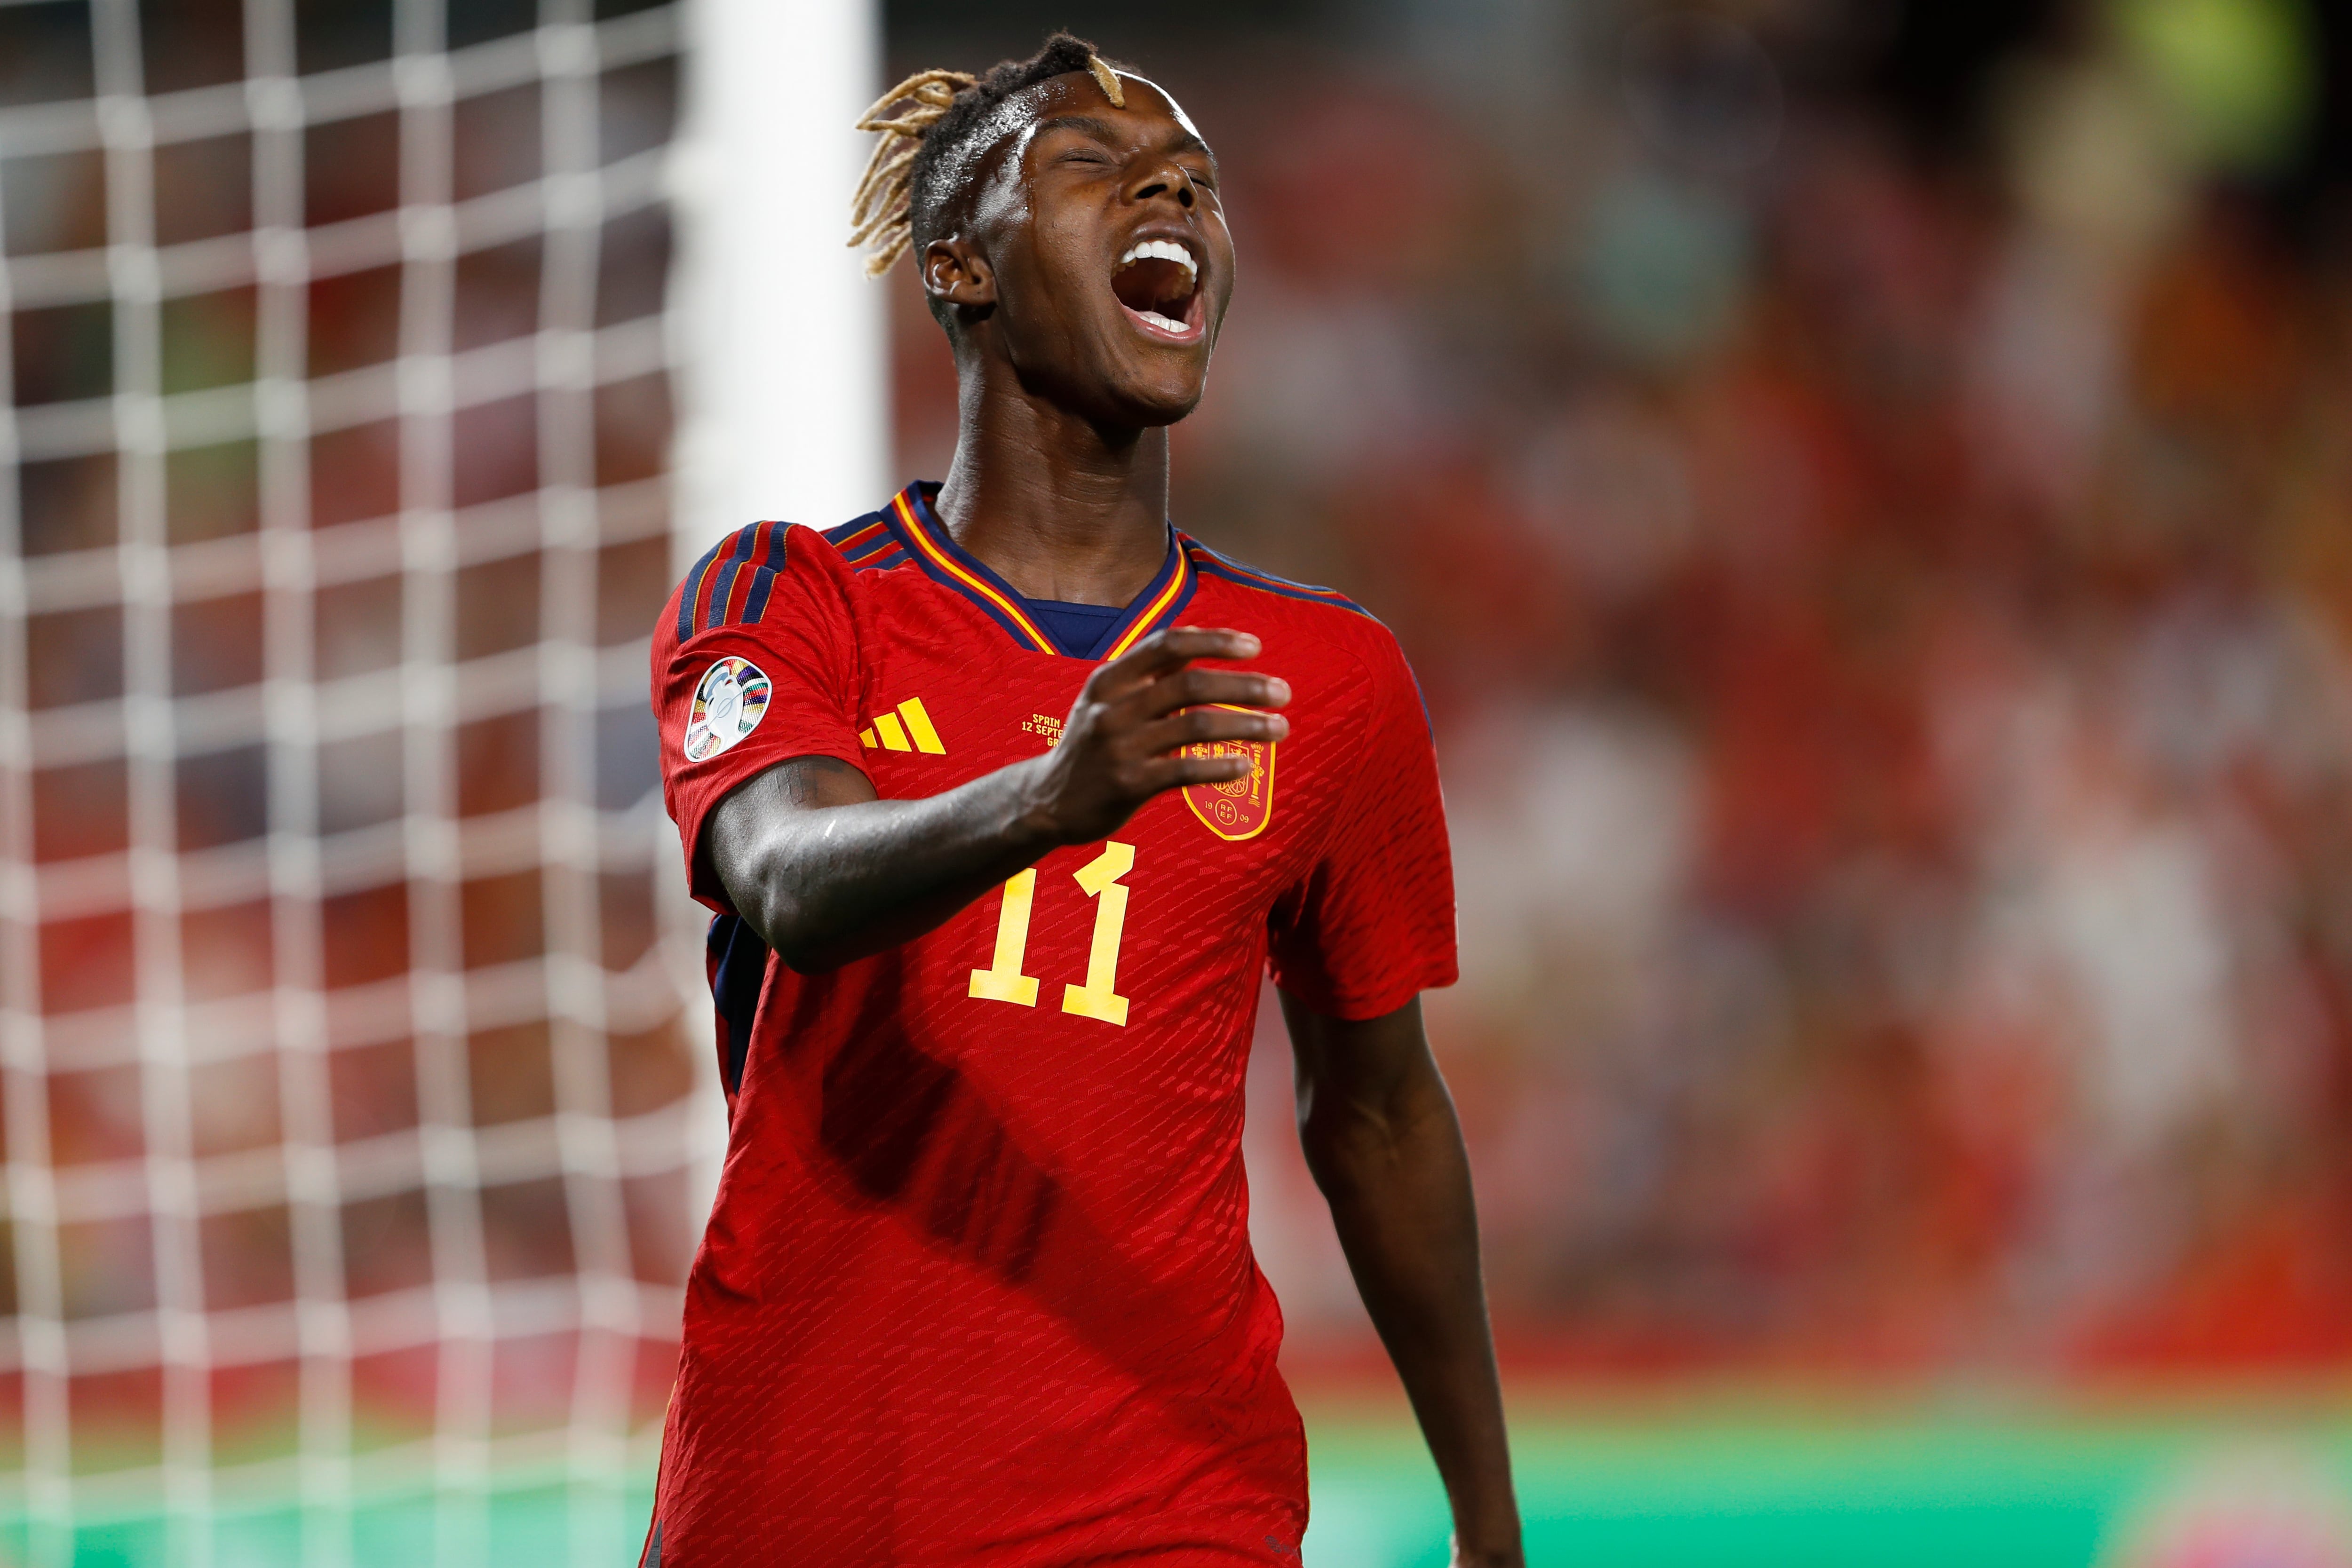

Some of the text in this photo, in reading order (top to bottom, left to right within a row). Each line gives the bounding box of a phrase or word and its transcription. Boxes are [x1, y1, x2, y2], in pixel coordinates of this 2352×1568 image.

[1033, 713, 1060, 728] SPAIN
[1022, 721, 1064, 738] 12 SEPTE
[1047, 737, 1060, 747] GR
[1205, 801, 1213, 809] 19
[1240, 814, 1249, 823] 09
[968, 840, 1136, 1027] 11
